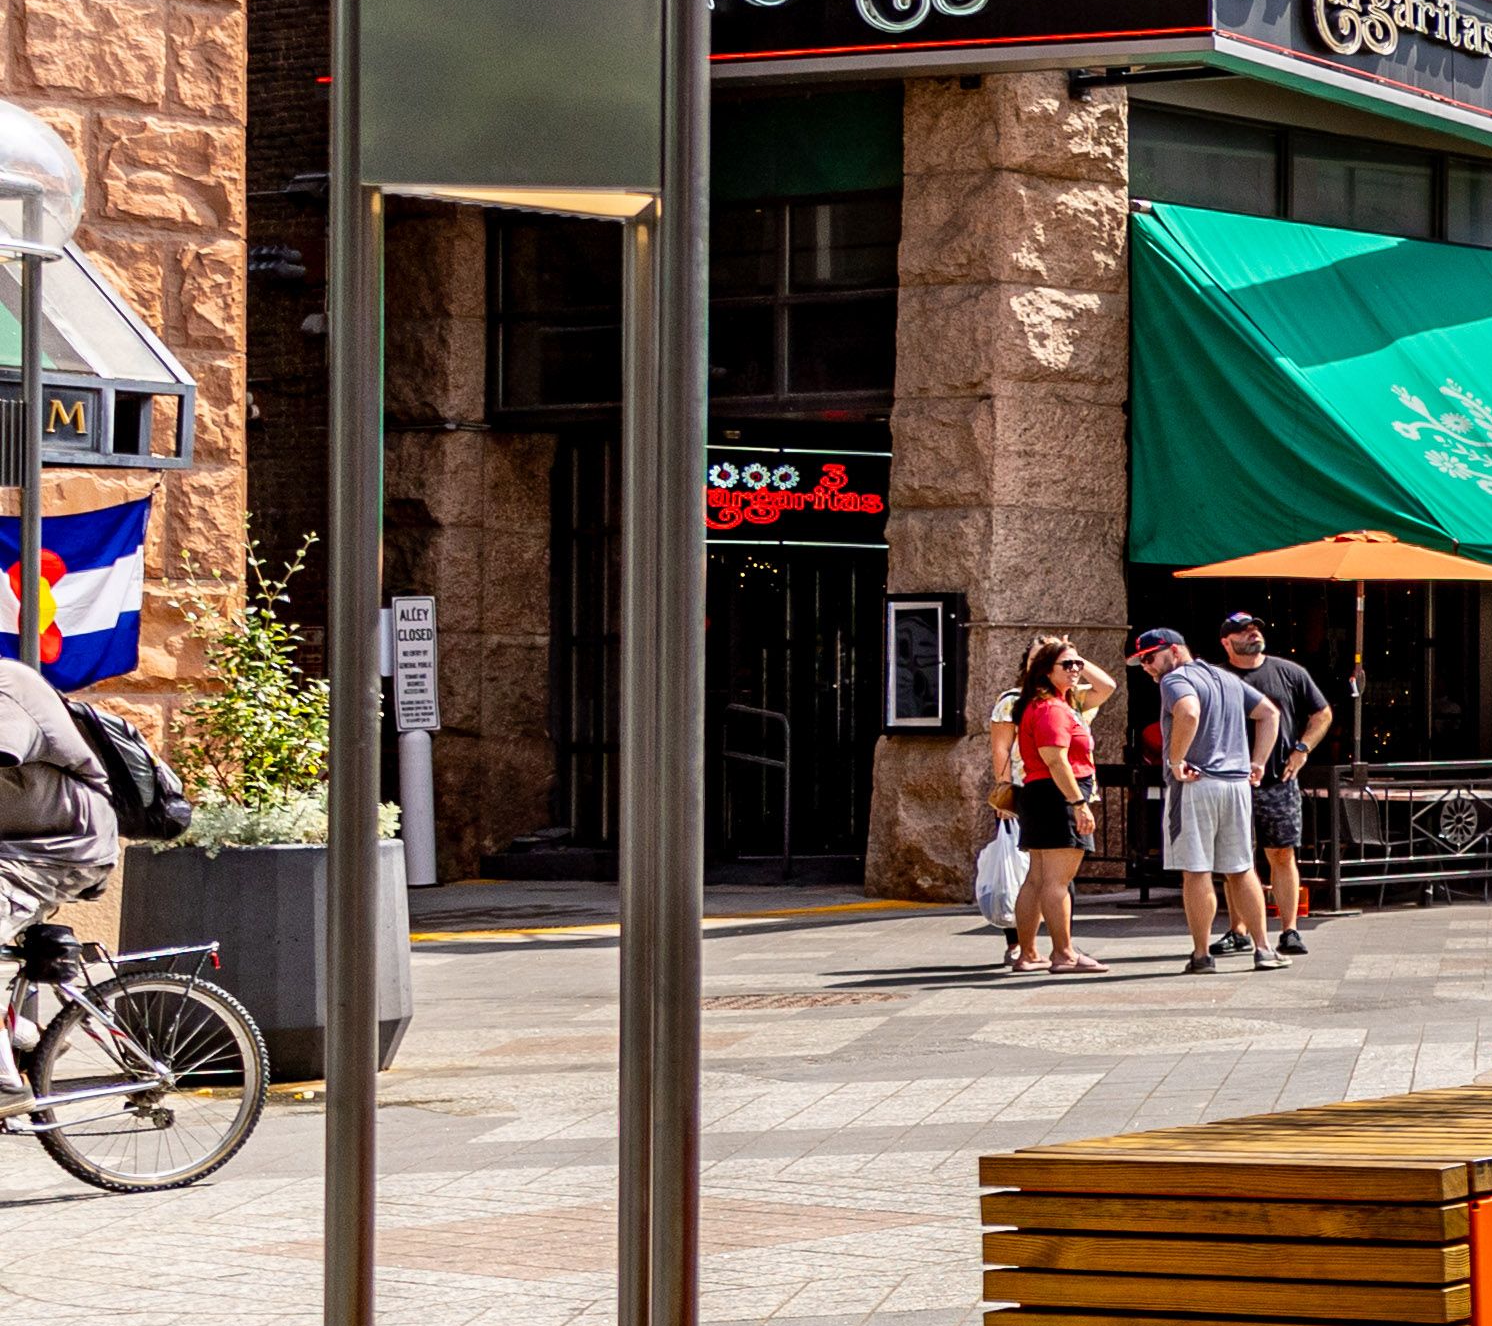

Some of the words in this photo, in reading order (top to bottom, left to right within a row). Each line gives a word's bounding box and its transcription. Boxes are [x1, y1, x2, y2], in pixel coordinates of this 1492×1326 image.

[46, 399, 87, 434] M
[819, 463, 848, 489] 3
[705, 485, 884, 530] argaritas
[400, 608, 429, 622] ALLEY
[398, 629, 433, 642] CLOSED
